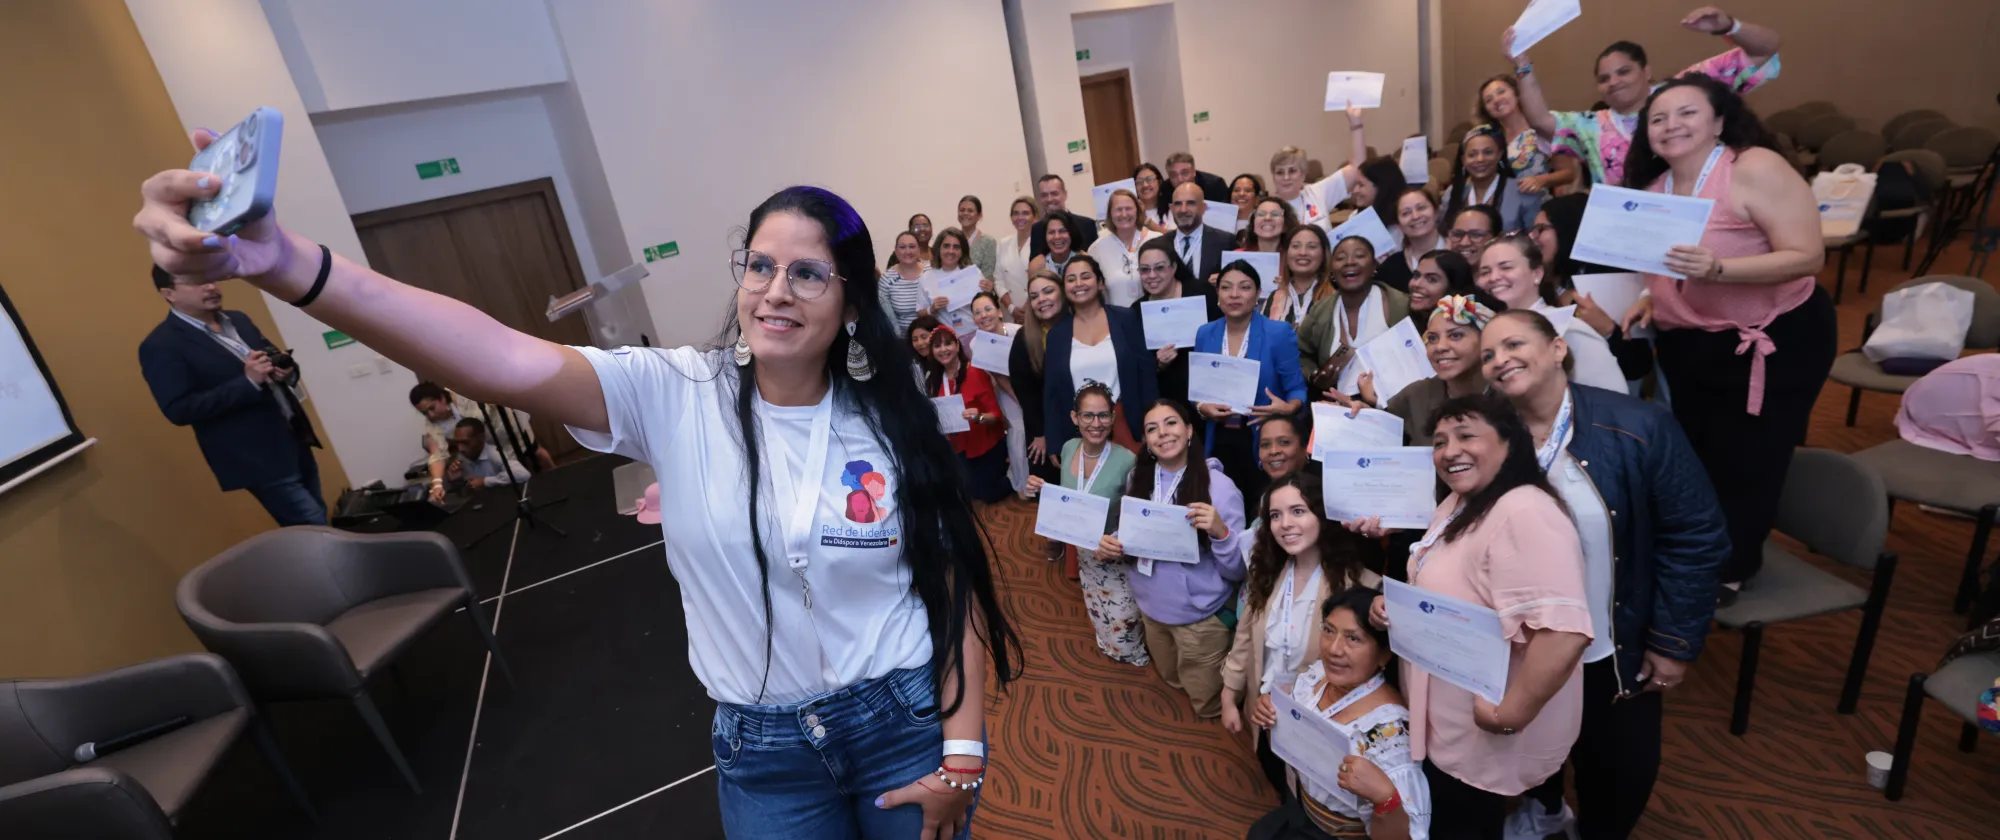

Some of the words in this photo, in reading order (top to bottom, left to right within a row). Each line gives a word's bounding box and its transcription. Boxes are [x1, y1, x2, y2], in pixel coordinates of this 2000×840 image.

[822, 524, 843, 536] Red
[845, 526, 858, 537] de
[860, 527, 898, 538] Lideresas
[833, 538, 860, 547] Diáspora
